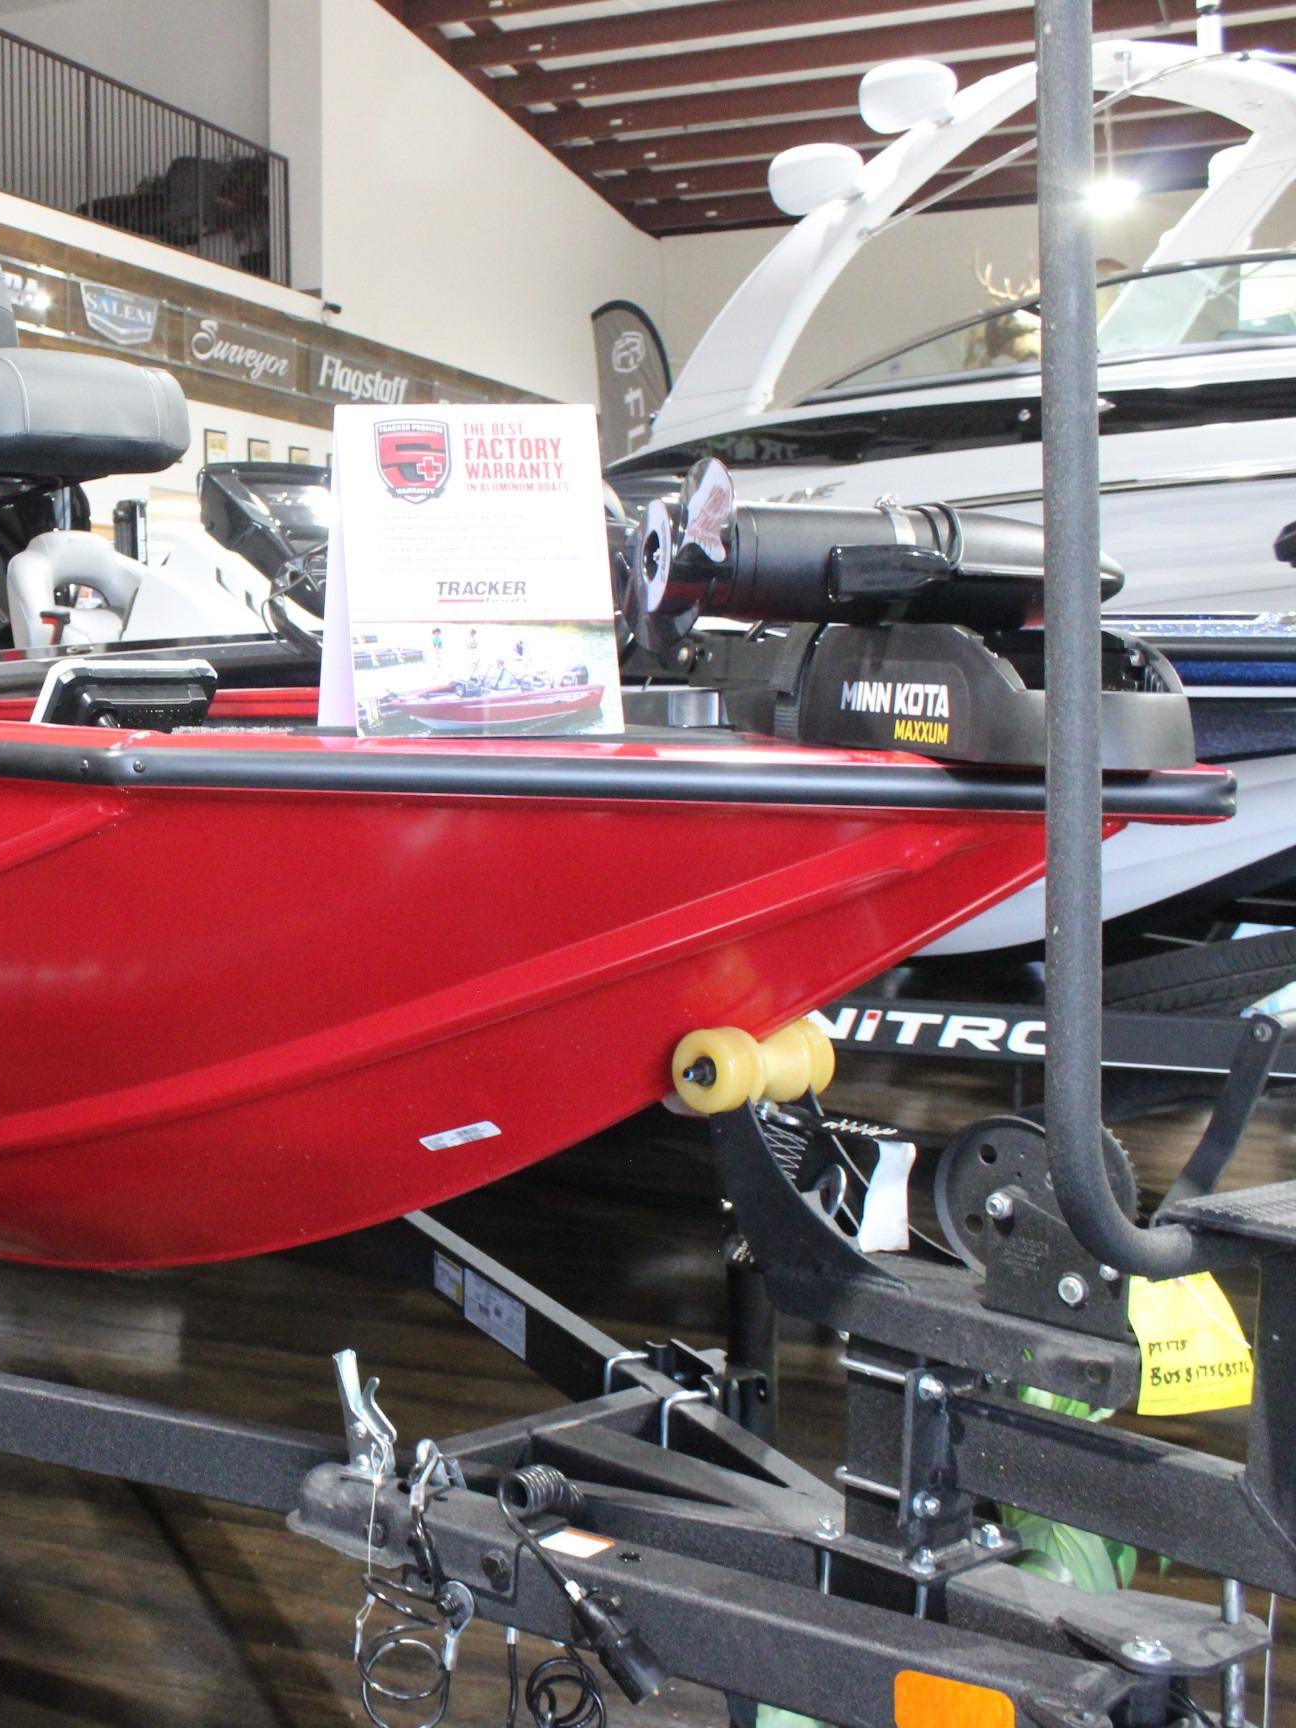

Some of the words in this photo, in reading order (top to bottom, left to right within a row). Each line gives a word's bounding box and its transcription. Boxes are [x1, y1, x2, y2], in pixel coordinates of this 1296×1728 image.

[84, 291, 155, 325] SALEM
[190, 319, 289, 379] Surveyor
[317, 354, 409, 404] Flagstaff
[462, 423, 486, 436] THE
[491, 423, 524, 436] BEST
[463, 437, 561, 460] FACTORY
[464, 462, 564, 480] WARRANTY
[466, 482, 477, 492] IN
[480, 482, 534, 492] ALUMINUM
[436, 580, 527, 597] TRACKER
[839, 680, 892, 714] MINN
[893, 682, 950, 719] KOTA
[894, 719, 949, 745] MAXXUM
